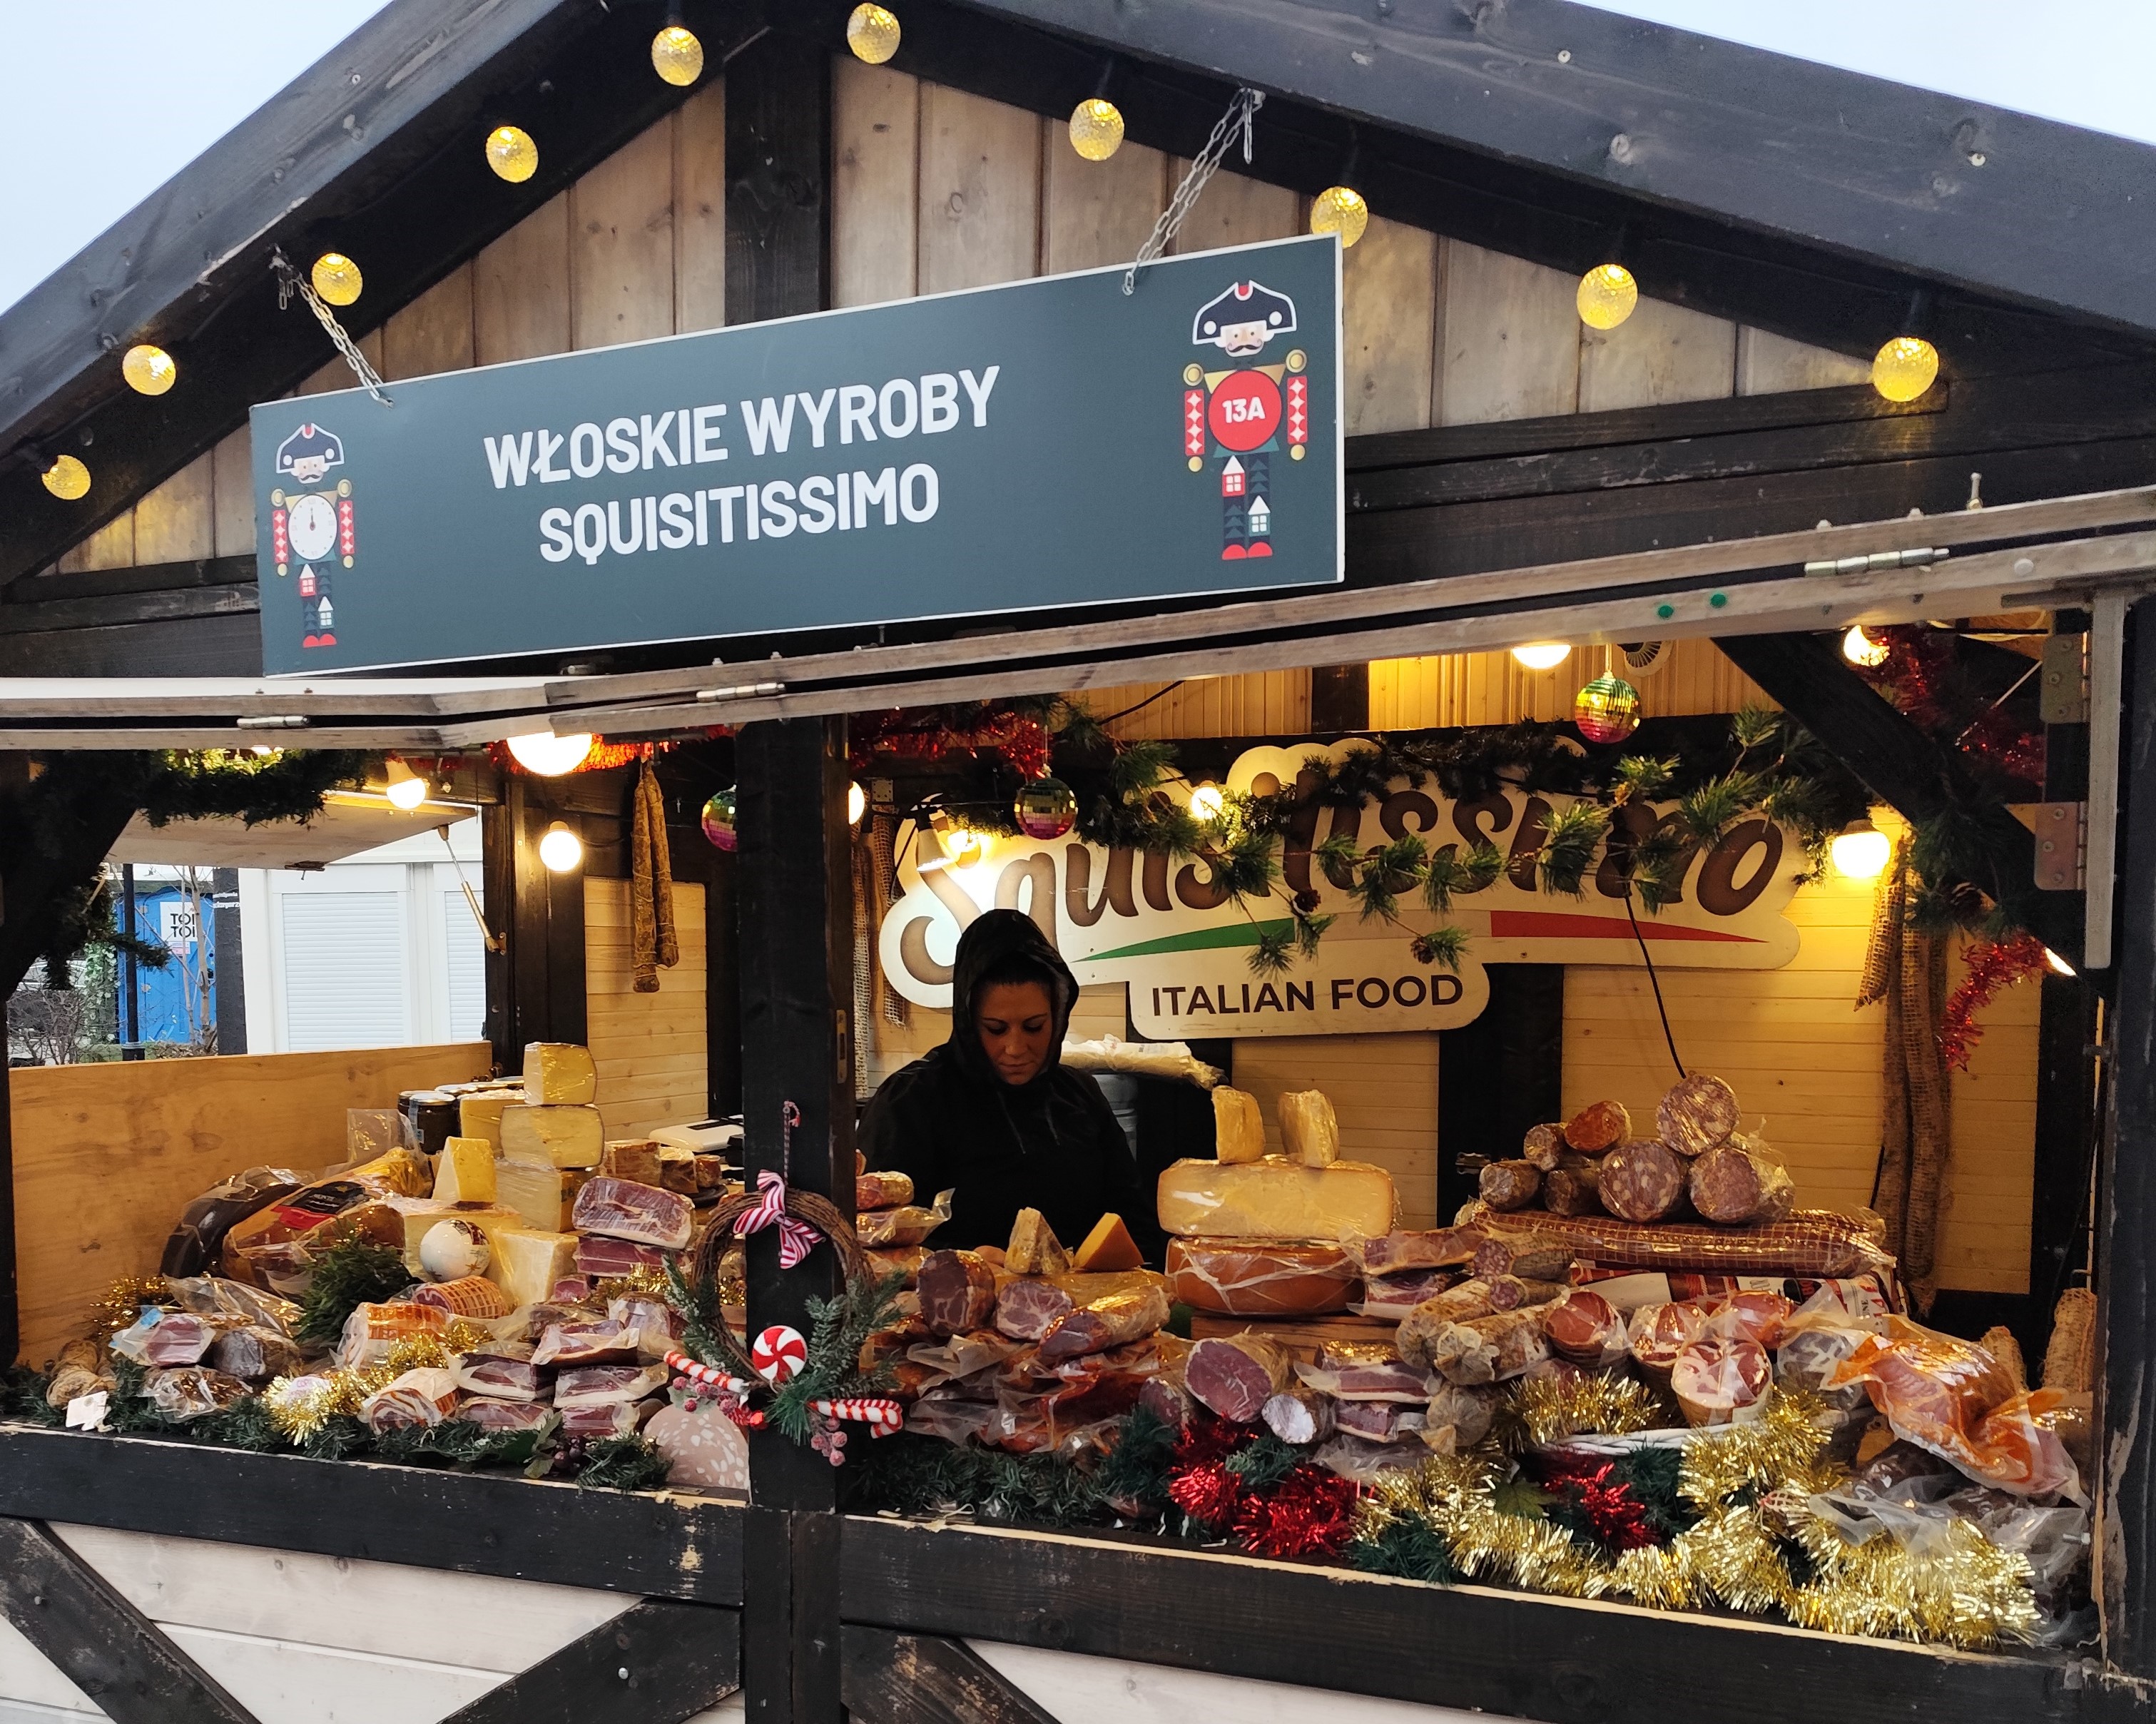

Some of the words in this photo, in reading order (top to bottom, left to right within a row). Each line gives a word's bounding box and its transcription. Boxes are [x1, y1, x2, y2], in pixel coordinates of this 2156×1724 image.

[483, 403, 729, 490] WŁOSKIE
[741, 365, 1000, 456] WYROBY
[1222, 396, 1266, 424] 13A
[539, 463, 940, 565] SQUISITISSIMO
[171, 913, 195, 926] TOI
[171, 926, 196, 938] TOI
[1152, 980, 1314, 1017] ITALIAN
[1331, 975, 1463, 1010] FOOD
